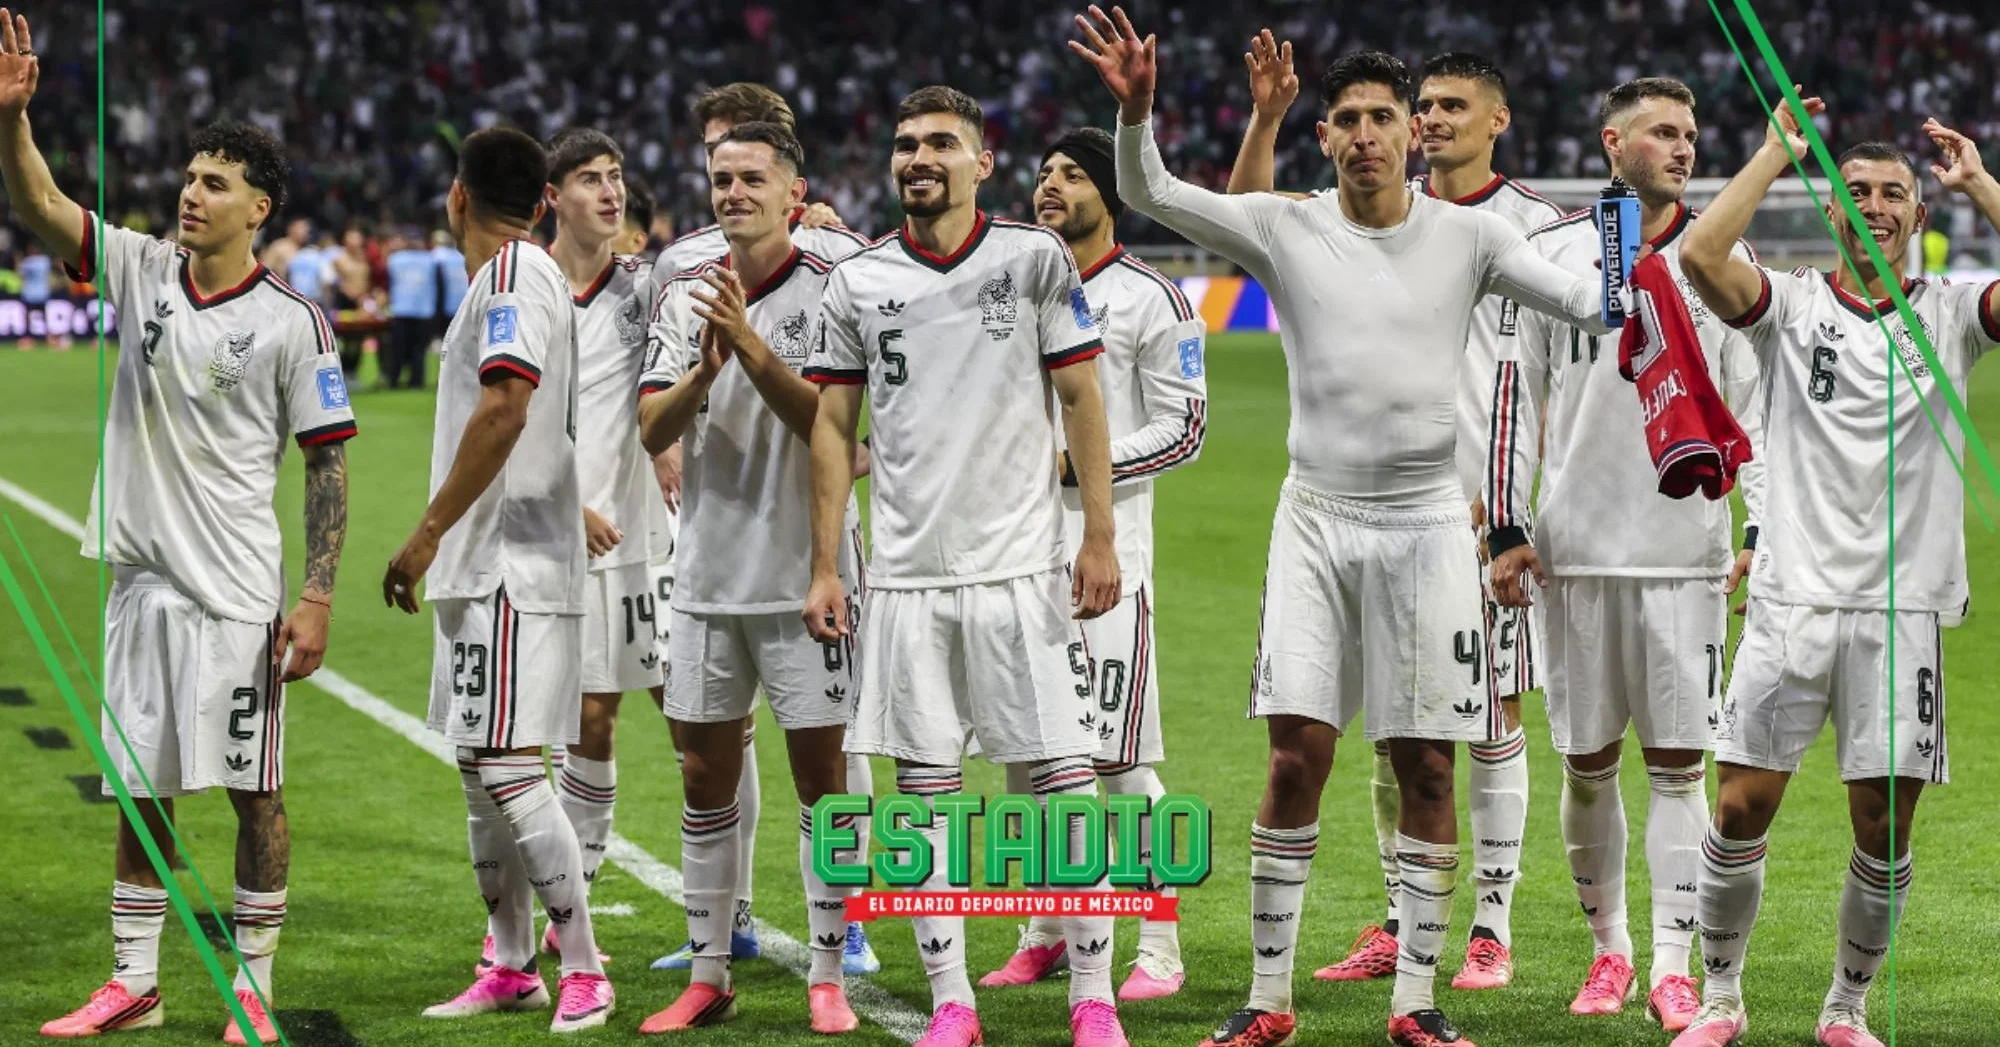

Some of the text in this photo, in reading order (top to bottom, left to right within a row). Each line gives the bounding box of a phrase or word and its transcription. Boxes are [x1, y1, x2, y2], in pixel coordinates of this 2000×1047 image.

[1603, 209, 1623, 312] POWERADE
[879, 328, 908, 386] 5
[1808, 346, 1838, 403] 6
[622, 592, 657, 645] 14
[453, 642, 487, 697] 23
[1067, 641, 1090, 698] 5
[1453, 629, 1480, 685] 4
[228, 687, 257, 740] 2
[1918, 667, 1934, 726] 6
